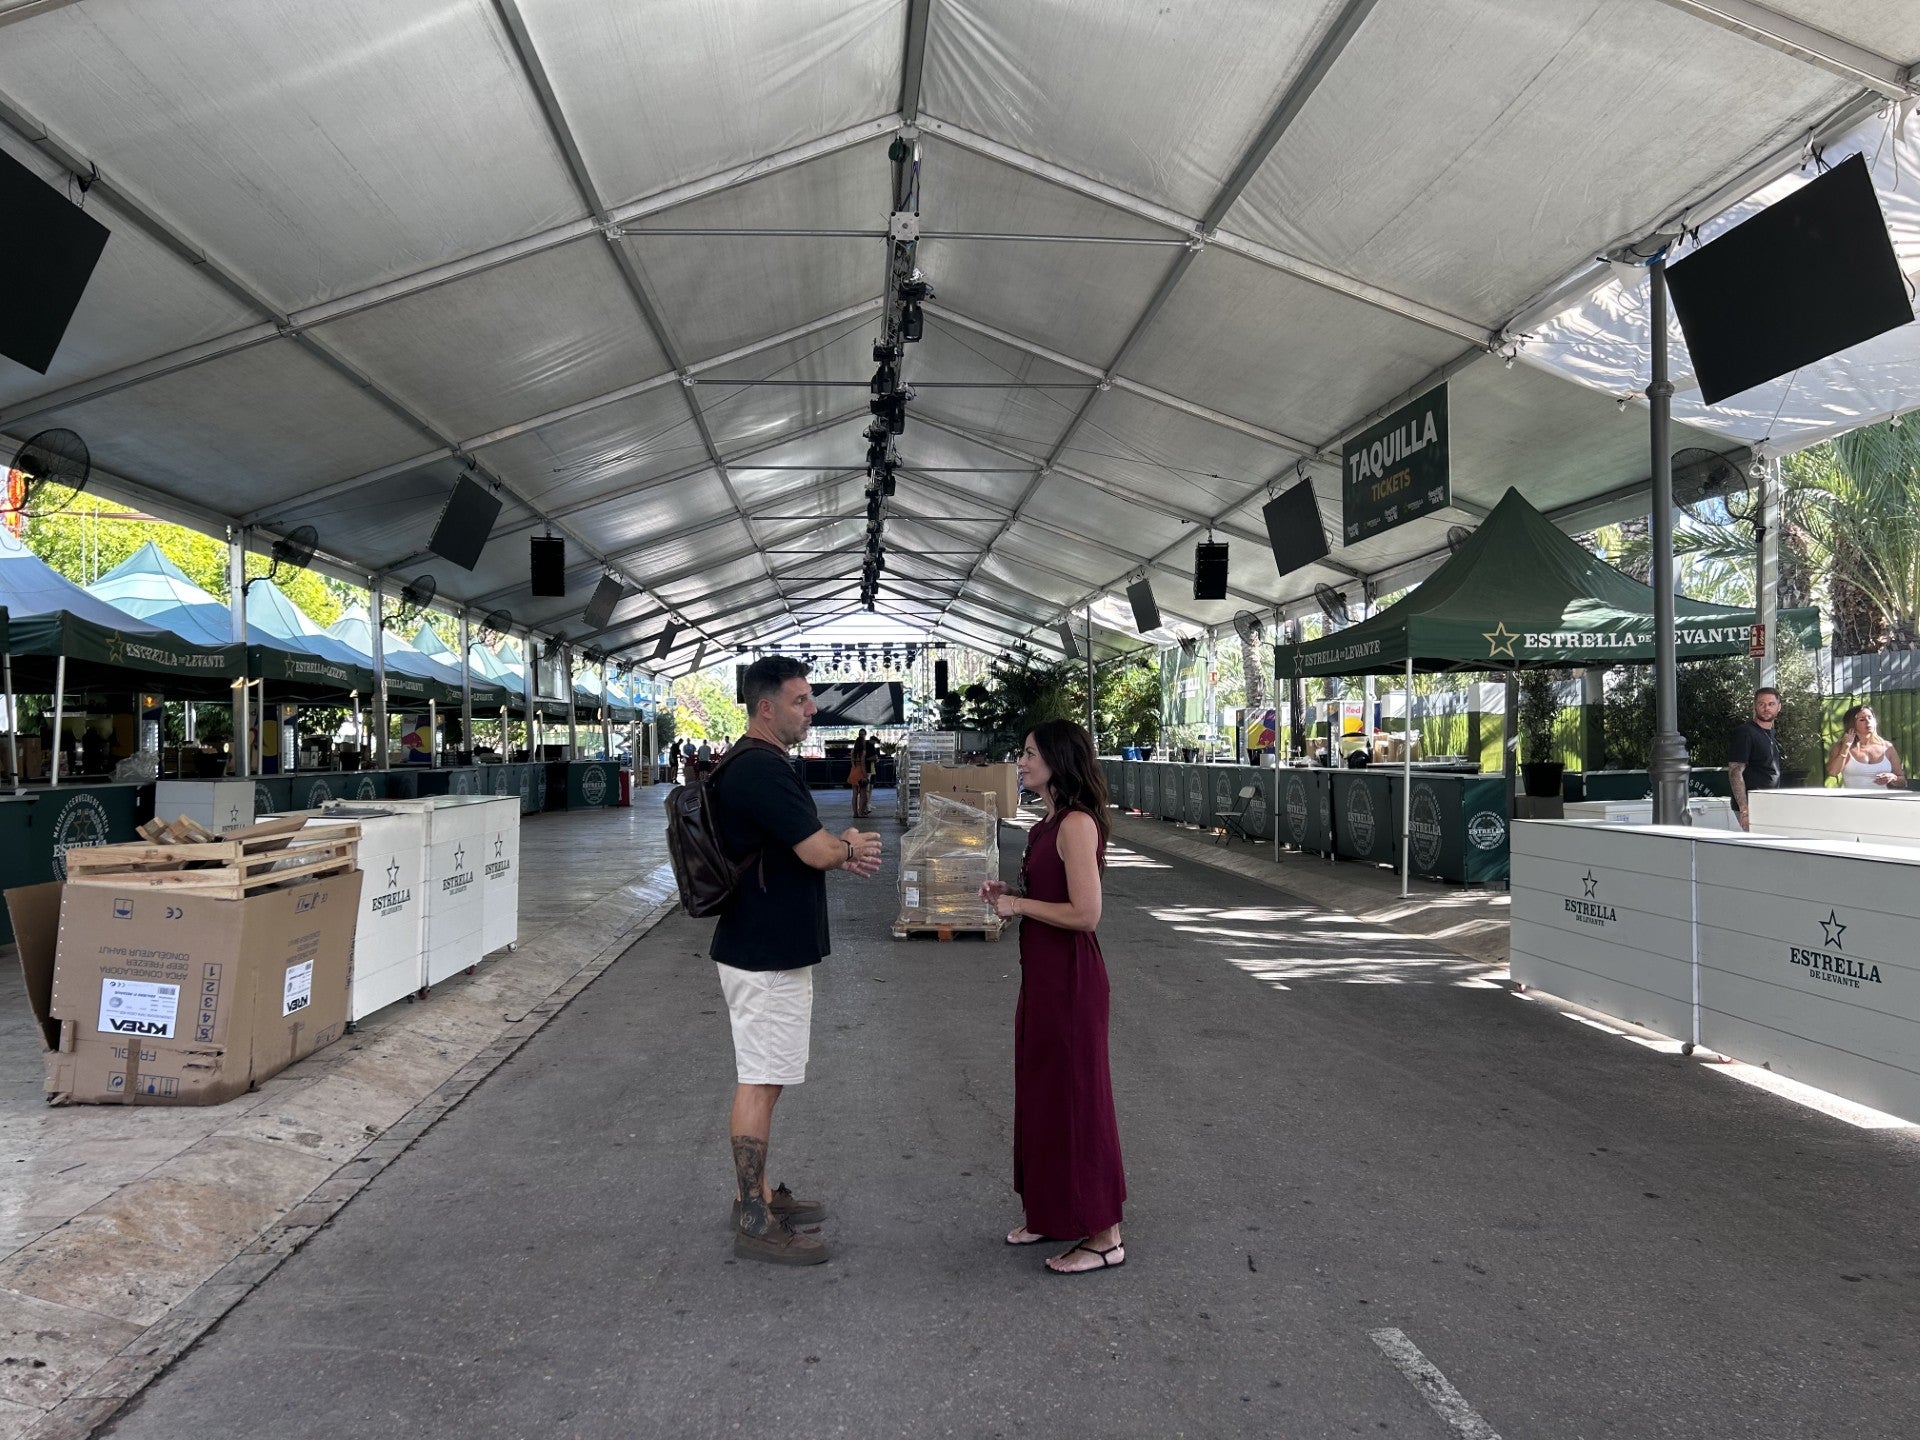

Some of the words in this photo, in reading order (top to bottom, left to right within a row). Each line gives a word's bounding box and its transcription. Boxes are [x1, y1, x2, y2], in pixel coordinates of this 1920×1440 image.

[1349, 410, 1438, 484] TAQUILLA
[1371, 468, 1412, 502] TICKETS
[1523, 631, 1637, 649] ESTRELLA
[1637, 635, 1652, 643] DE
[1652, 626, 1751, 646] EVANTE
[126, 643, 178, 666] ESTRELLA
[185, 655, 225, 668] LEVANTE
[1305, 648, 1341, 666] ESTRELLA
[1345, 639, 1381, 660] LEVANTE
[1345, 704, 1361, 715] Red
[1468, 827, 1505, 835] ESTRELLA
[485, 858, 511, 876] ESTRELLA
[442, 870, 474, 891] ESTRELLA
[372, 888, 411, 912] ESTRELLA
[1564, 898, 1617, 922] ESTRELLA
[1575, 914, 1582, 922] DE
[1582, 916, 1605, 928] LEVANTE
[97, 946, 127, 956] BAHUT
[100, 966, 163, 978] CONGELADORA
[126, 959, 164, 969] FREEZER
[166, 962, 189, 971] DEEP
[209, 966, 216, 978] 1
[1789, 947, 1882, 984] ESTRELLA
[165, 972, 188, 980] ARCA
[1809, 969, 1821, 980] DE
[1821, 973, 1861, 989] LEVANTE
[205, 981, 215, 993] 2
[203, 997, 213, 1009] 3
[287, 995, 308, 1012] KREA
[202, 1012, 212, 1024] 4
[109, 1018, 168, 1036] KREA
